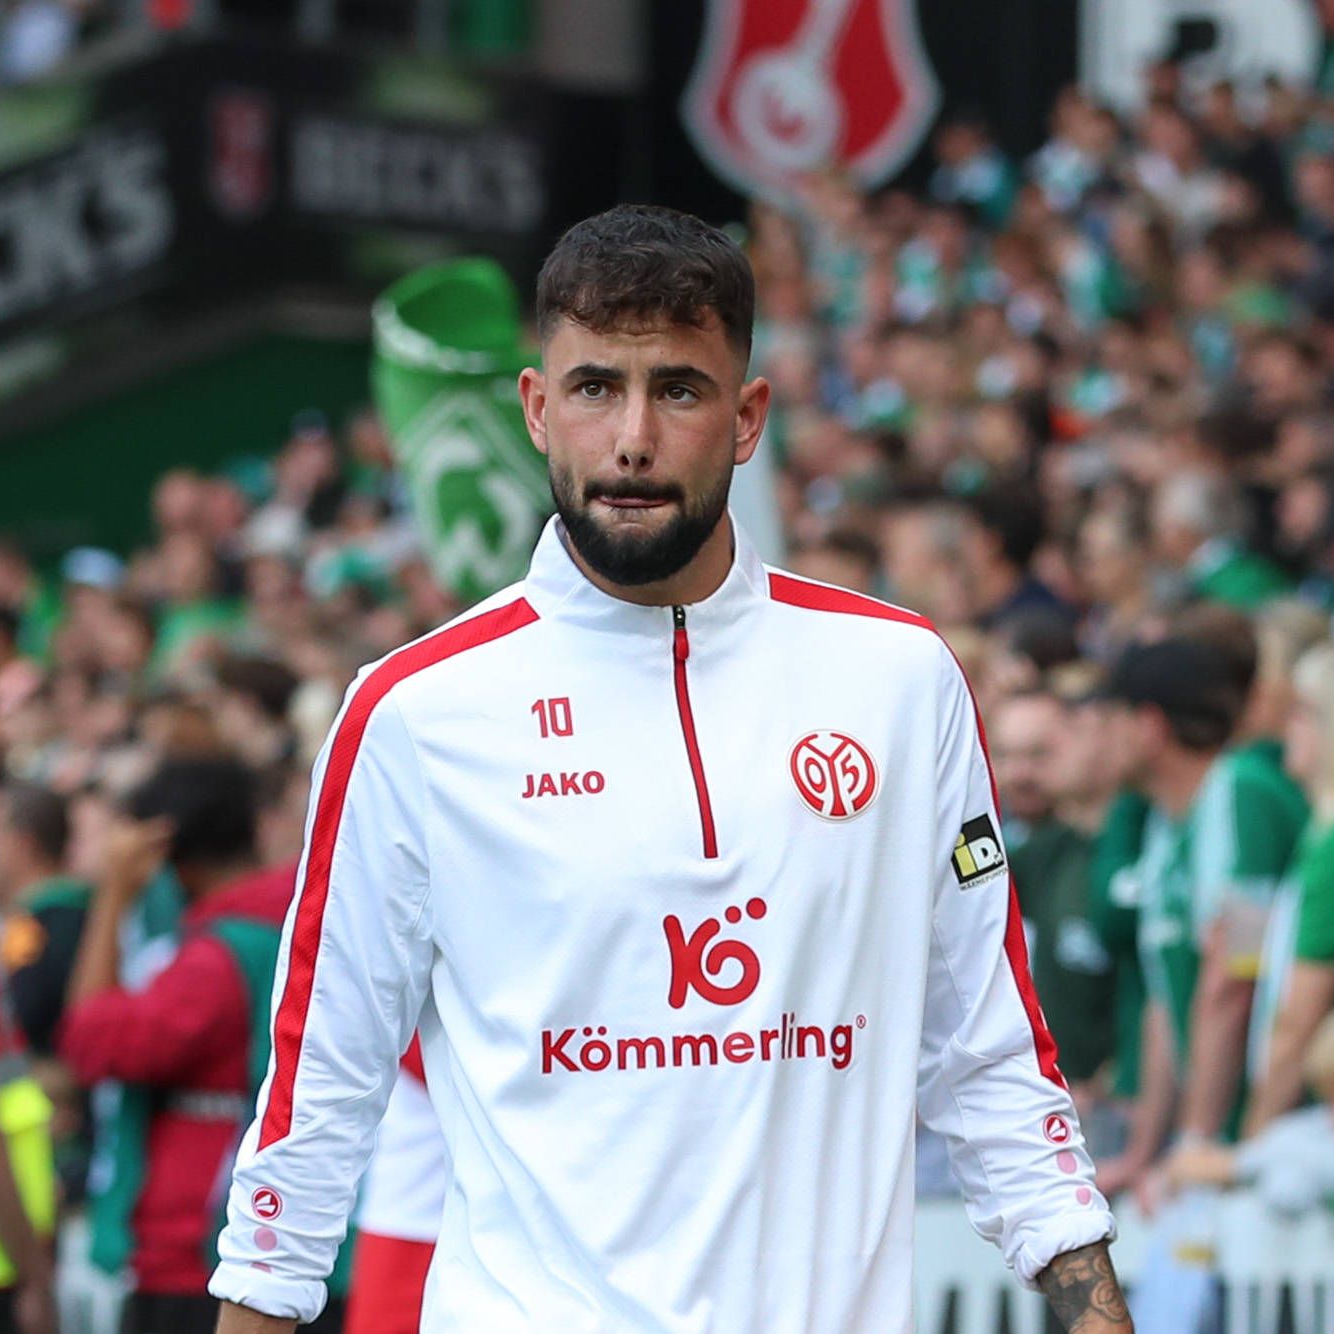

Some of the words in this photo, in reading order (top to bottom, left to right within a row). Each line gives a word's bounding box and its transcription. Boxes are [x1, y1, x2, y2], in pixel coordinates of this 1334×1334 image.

[531, 696, 574, 738] 10
[521, 770, 606, 799] JAKO
[540, 1012, 854, 1075] Kömmerling
